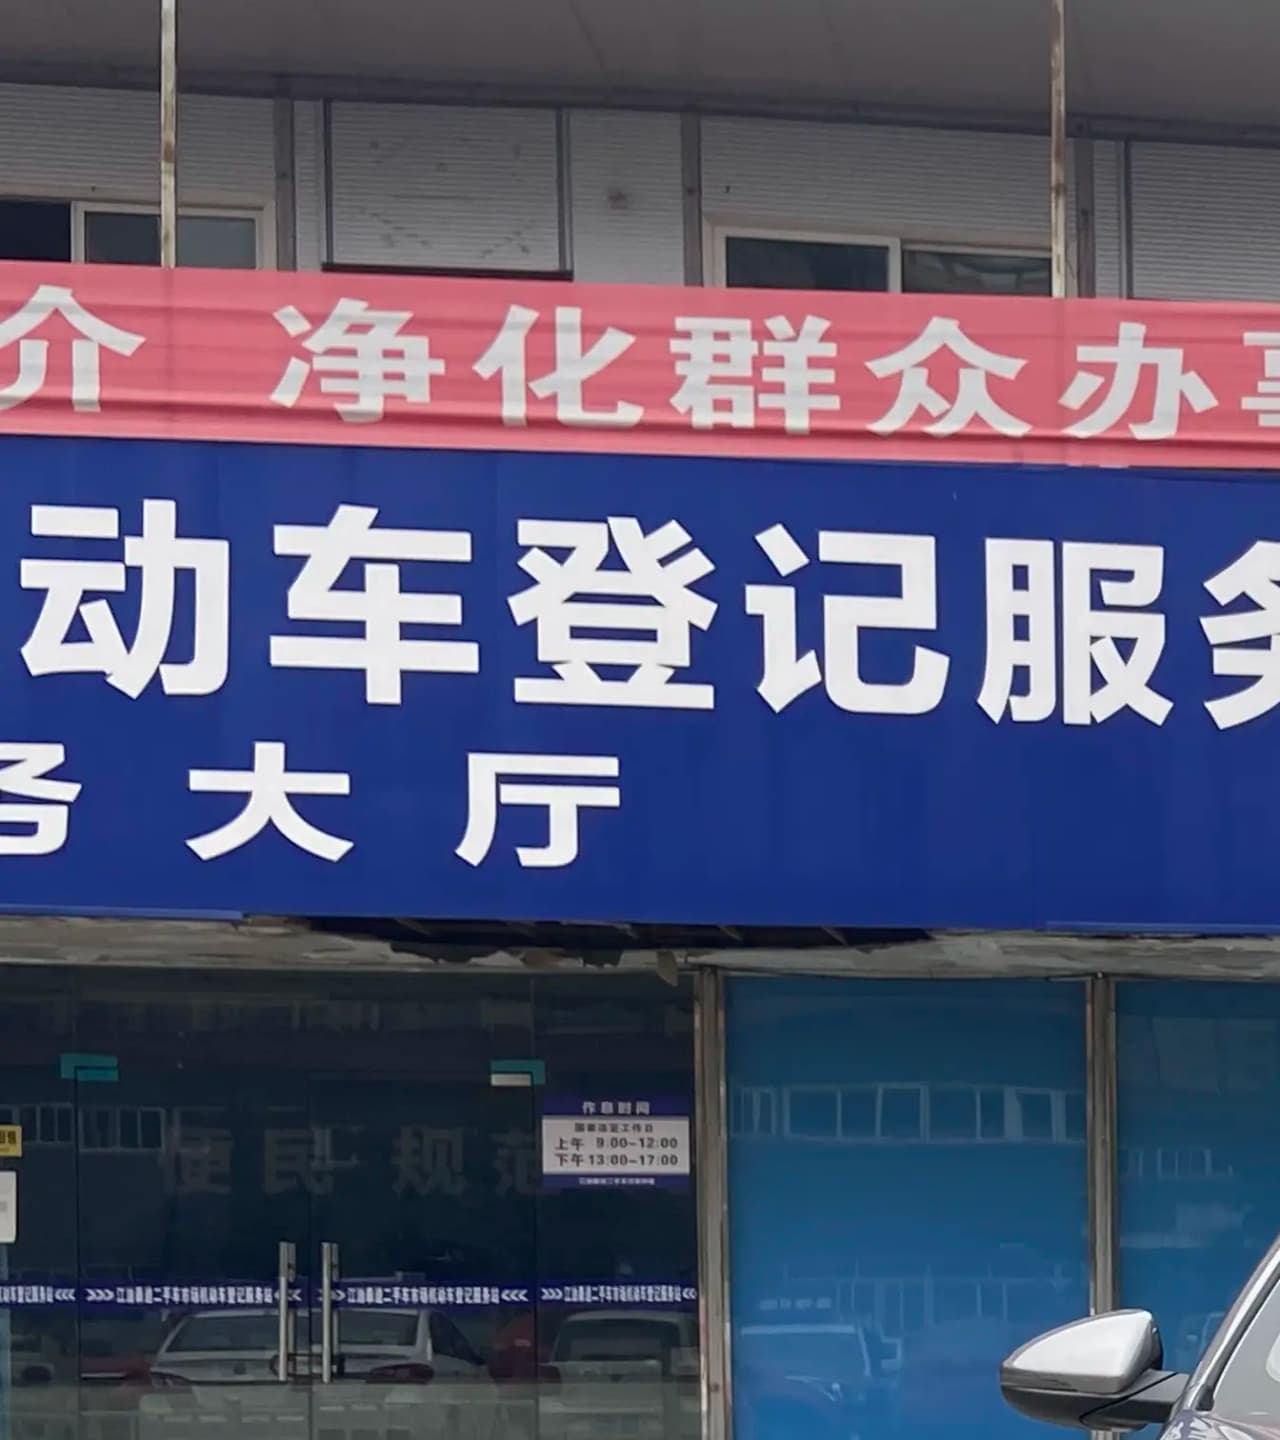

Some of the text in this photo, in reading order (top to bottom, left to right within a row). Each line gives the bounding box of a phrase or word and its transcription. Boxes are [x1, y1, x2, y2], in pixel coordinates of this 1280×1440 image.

[0, 285, 146, 413] 介
[582, 1101, 650, 1115] 作息时间
[555, 1137, 584, 1151] 上午
[555, 1153, 584, 1167] 下午
